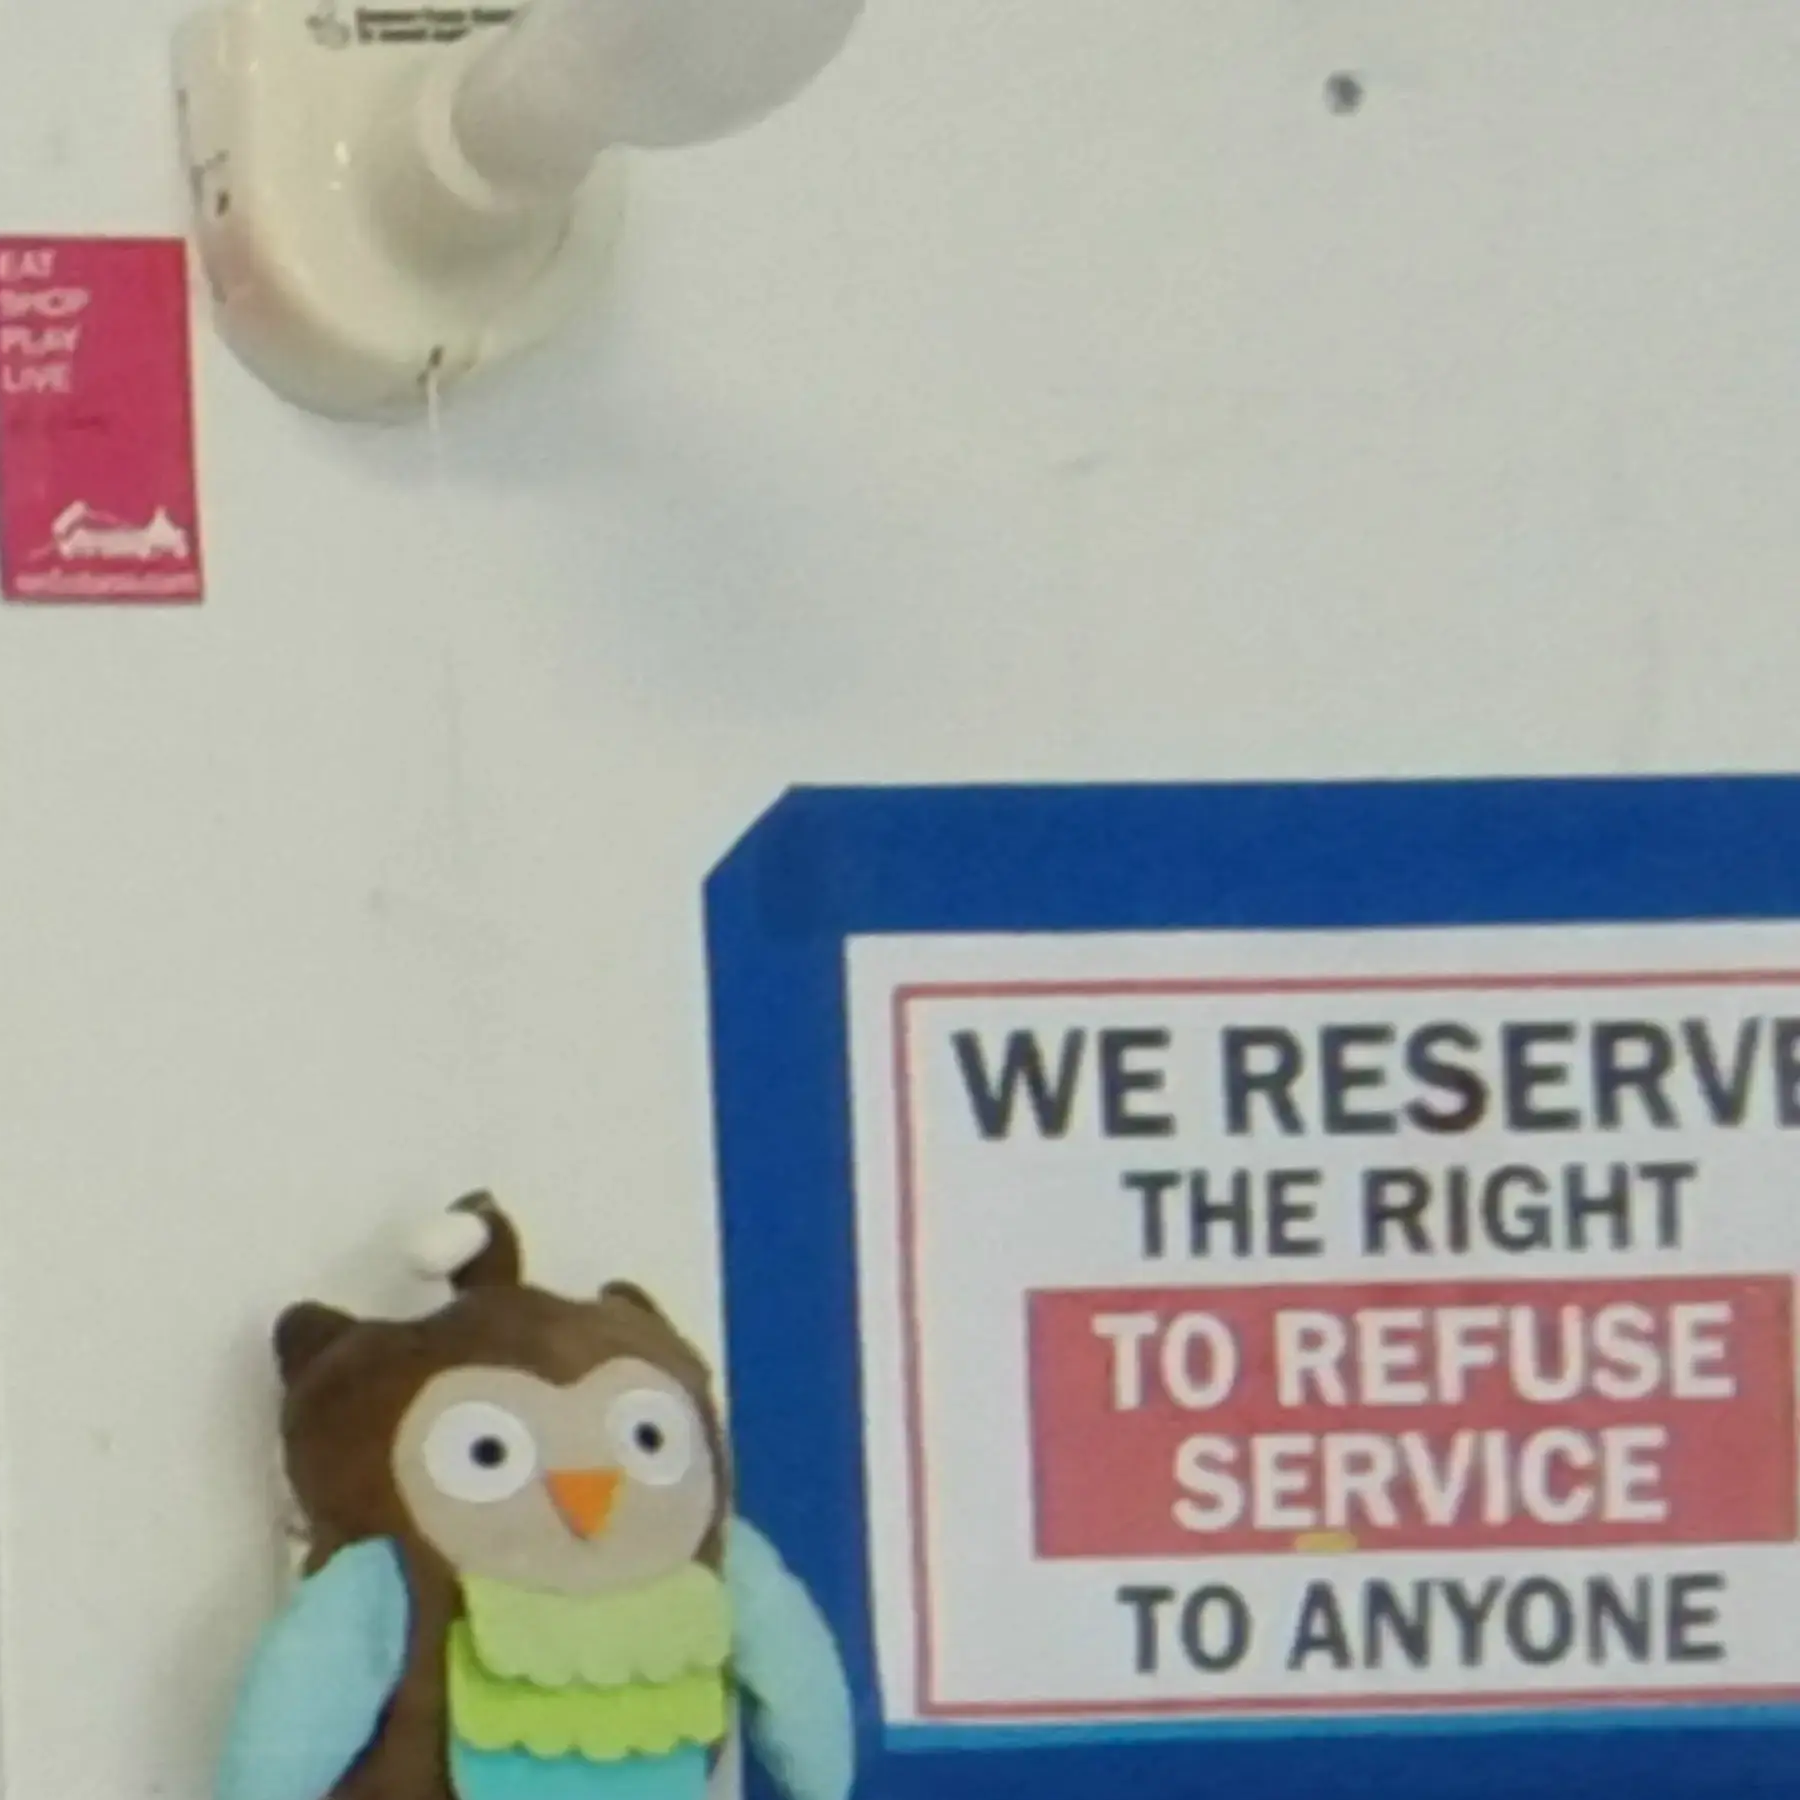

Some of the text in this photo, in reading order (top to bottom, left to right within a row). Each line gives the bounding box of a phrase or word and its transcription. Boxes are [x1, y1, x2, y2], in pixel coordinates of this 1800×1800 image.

[0, 325, 81, 353] PLAY
[2, 363, 72, 393] LIVE
[953, 1027, 1177, 1140] WE
[1121, 1160, 1698, 1259] THE RIGHT
[1092, 1301, 1739, 1410] TO REFUSE
[1170, 1427, 1670, 1531] SERVICE
[1116, 1571, 1727, 1673] TO ANYONE
